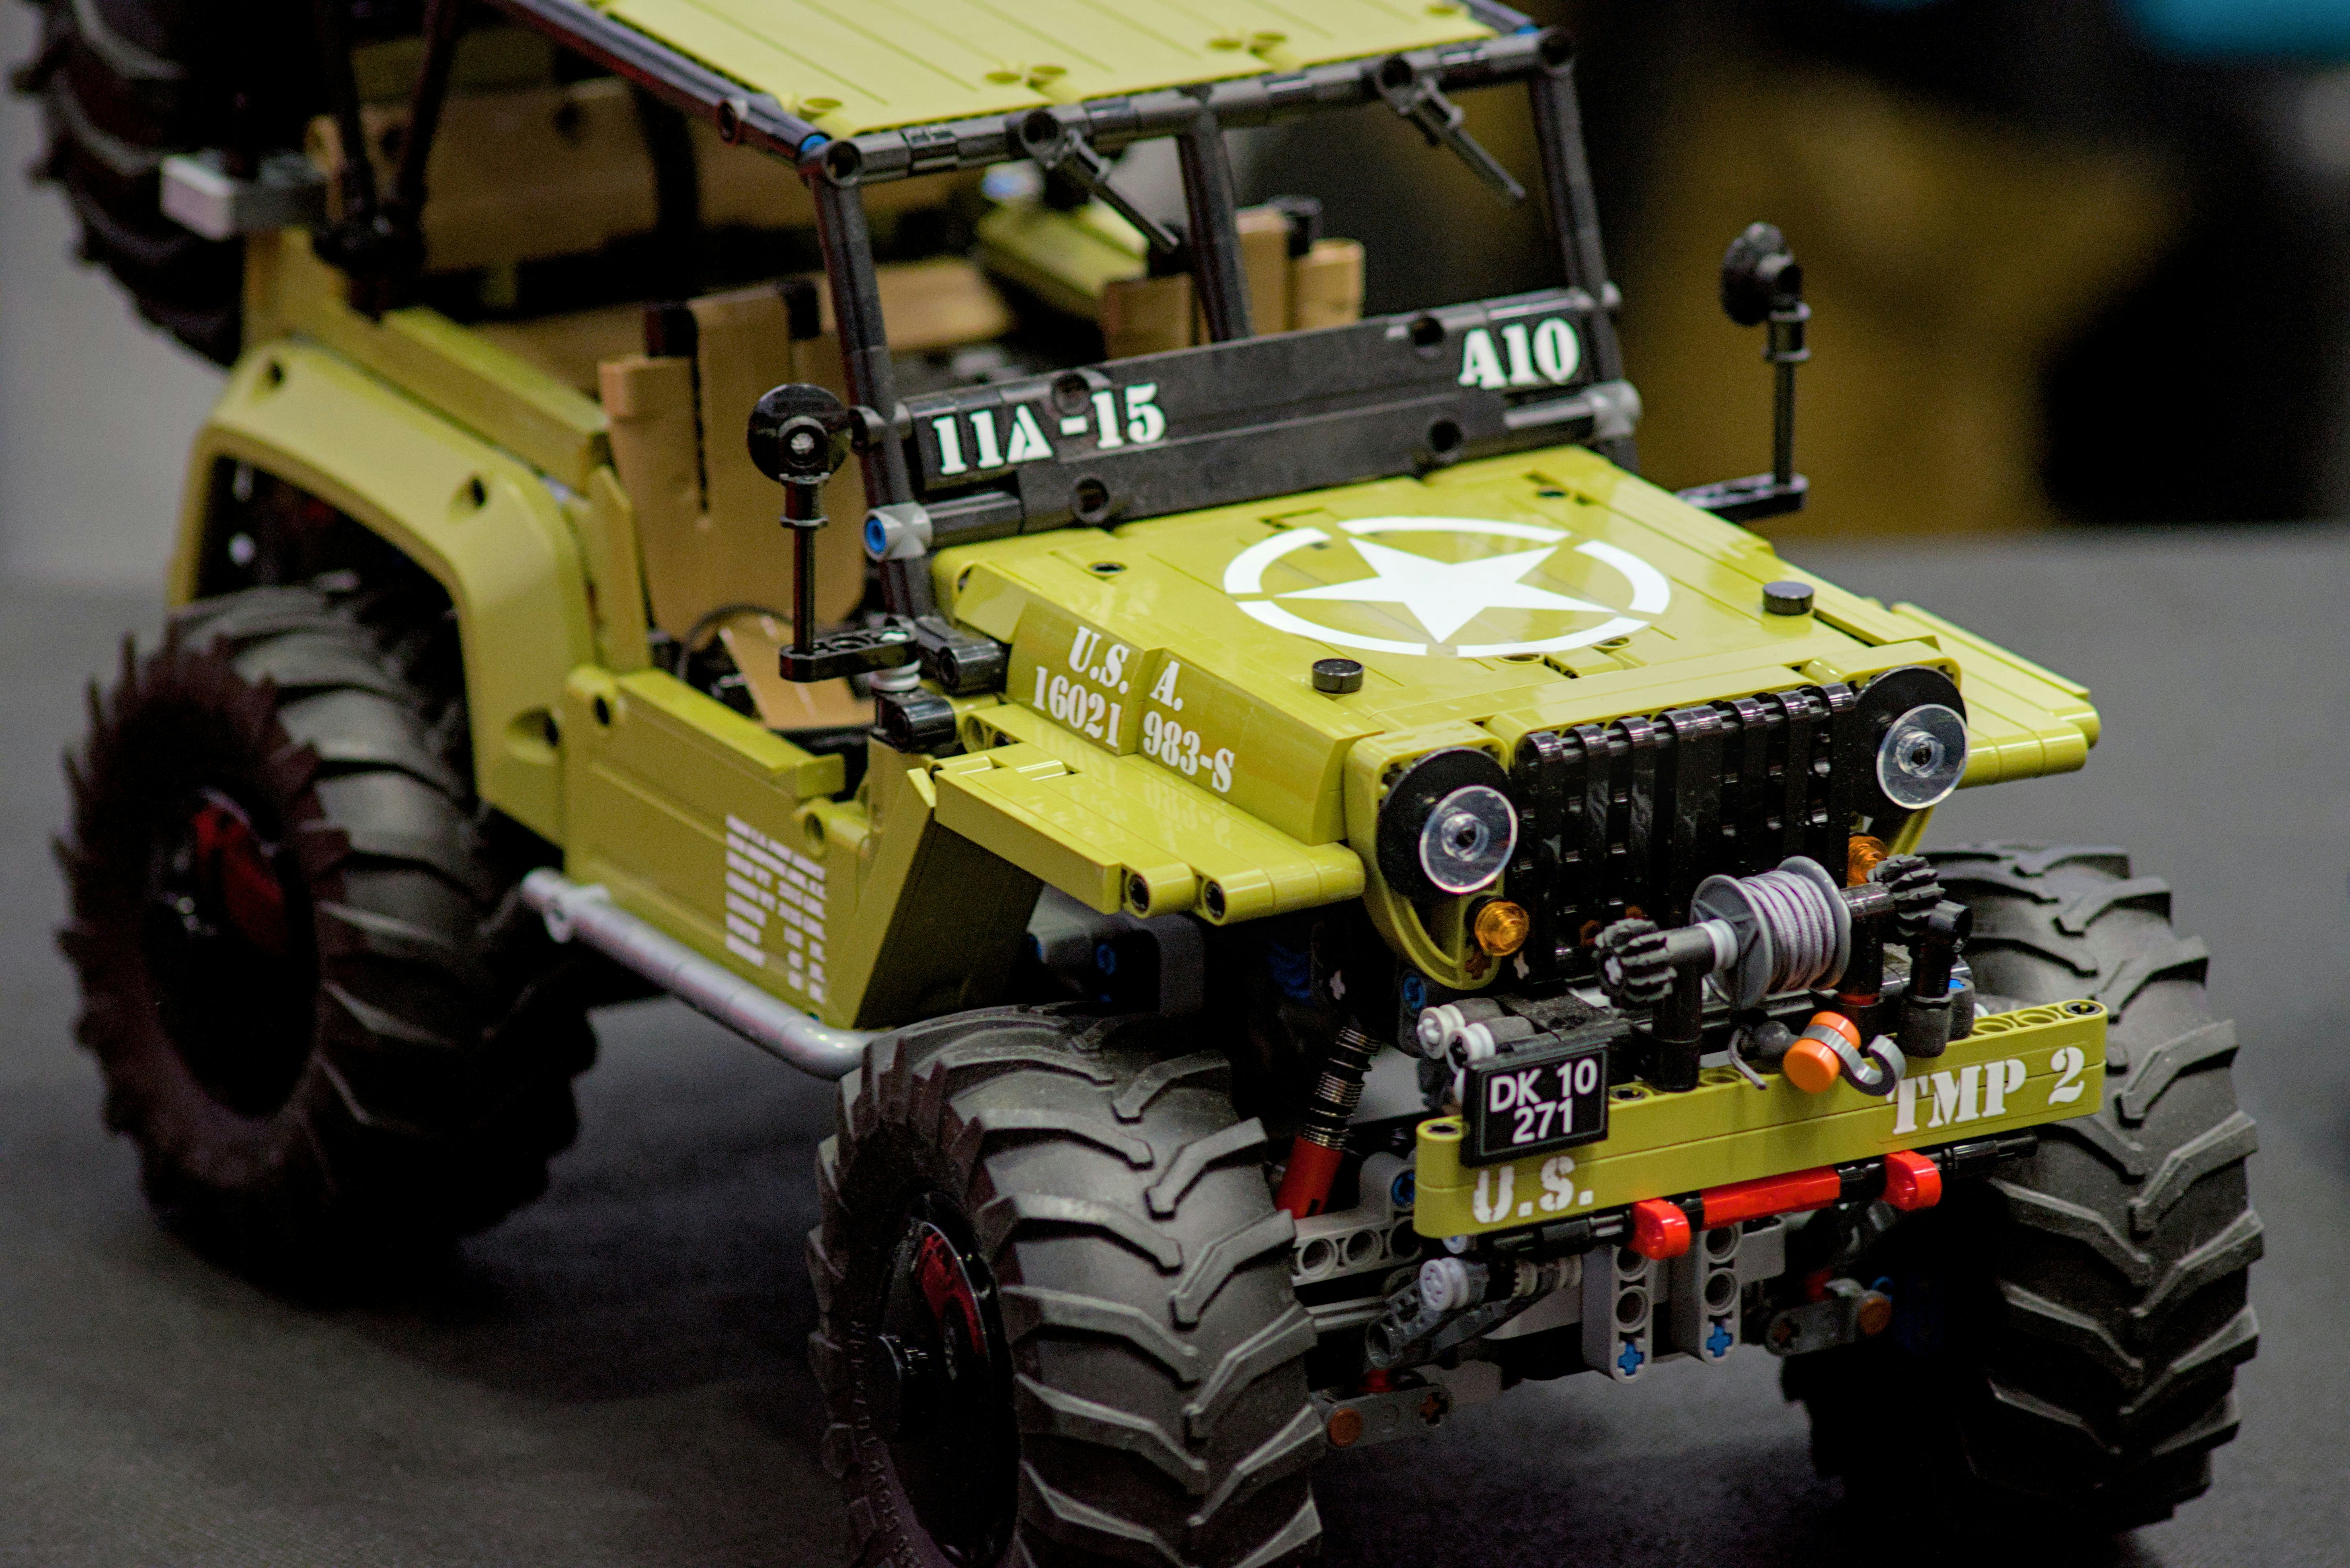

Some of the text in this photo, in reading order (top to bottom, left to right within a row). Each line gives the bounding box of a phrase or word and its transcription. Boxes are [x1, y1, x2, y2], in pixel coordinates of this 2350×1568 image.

[1458, 319, 1581, 389] A10
[1068, 625, 1183, 711] U.S. A.
[1032, 666, 1236, 793] 16021 983-S
[1490, 1058, 1598, 1113] DK 10
[1512, 1097, 1573, 1144] 271
[1885, 1047, 2085, 1135] TMP 2
[1473, 1156, 1594, 1224] U.S.
